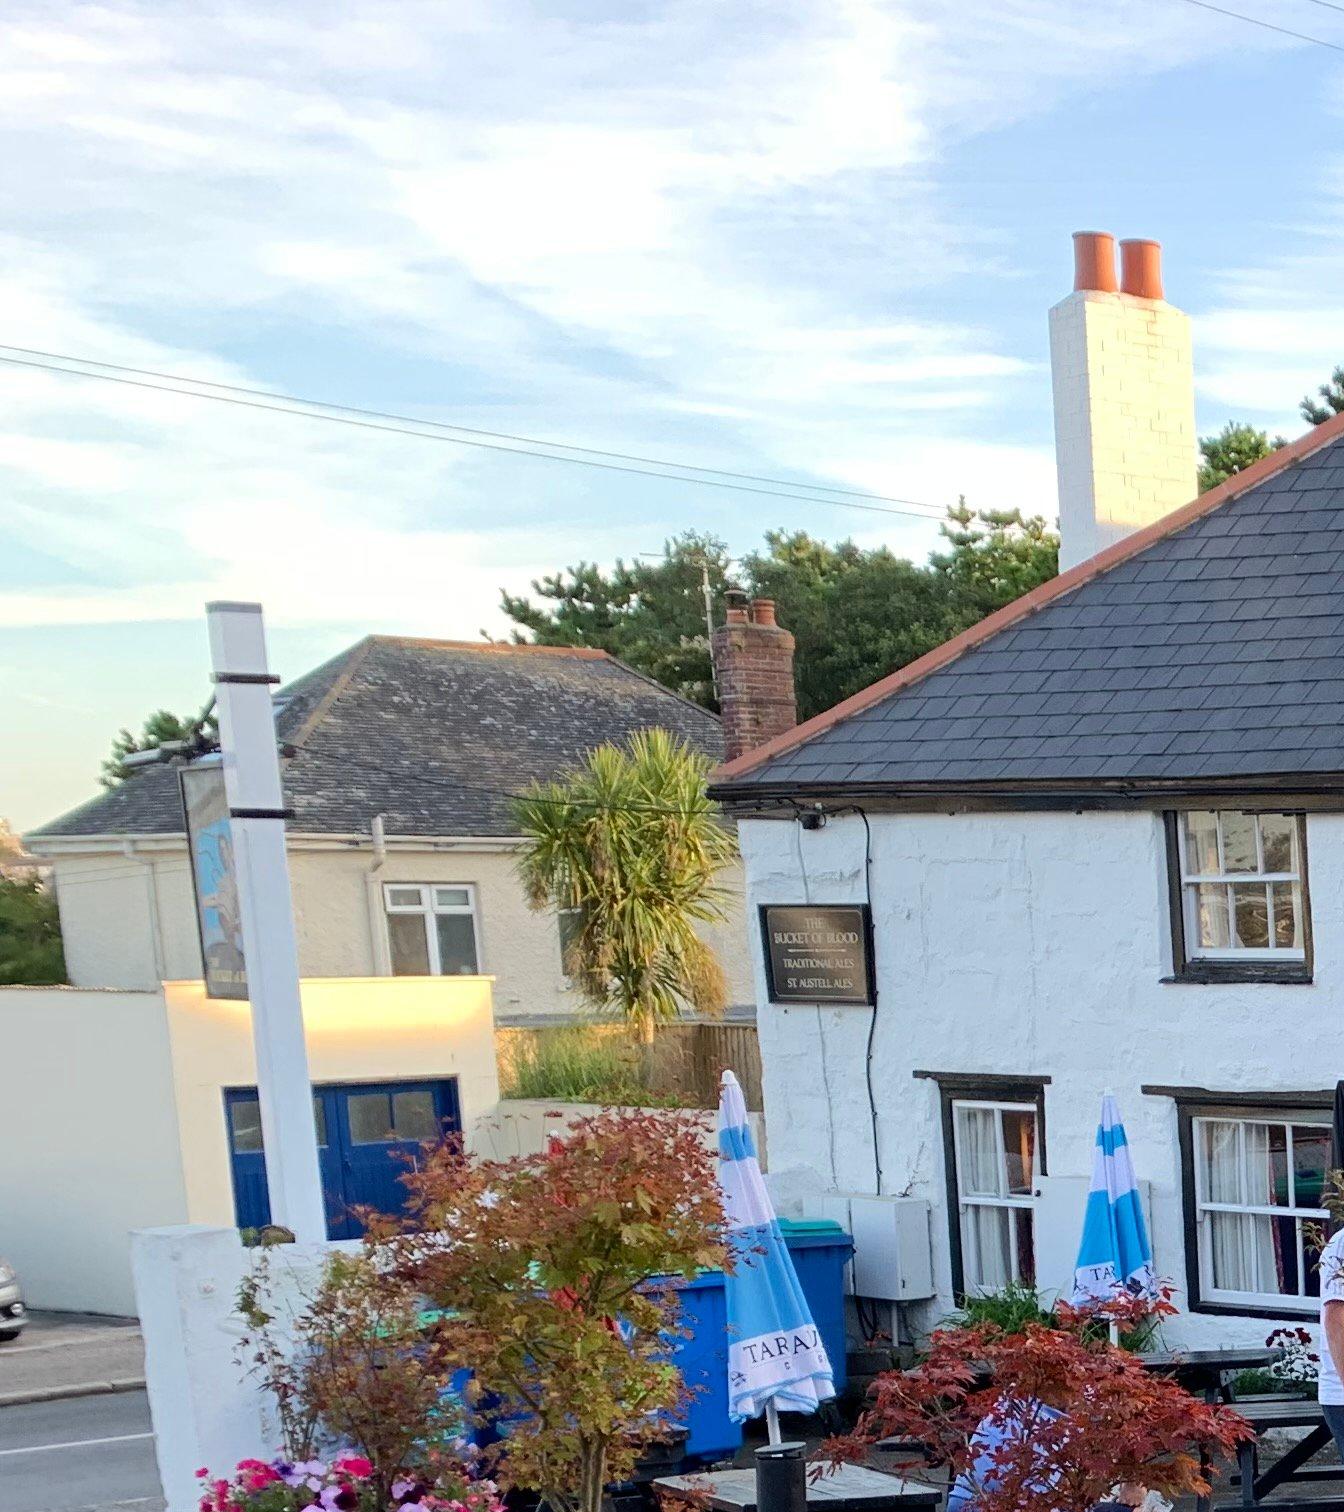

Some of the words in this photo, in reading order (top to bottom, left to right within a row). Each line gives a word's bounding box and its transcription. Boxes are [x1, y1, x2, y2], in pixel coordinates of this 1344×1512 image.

[774, 932, 809, 944] BUCKET
[826, 932, 859, 944] BLOOD
[783, 958, 833, 969] TRADITIONAL
[835, 959, 855, 969] ALES
[799, 978, 833, 988] AUSTELL
[834, 979, 854, 989] ALES
